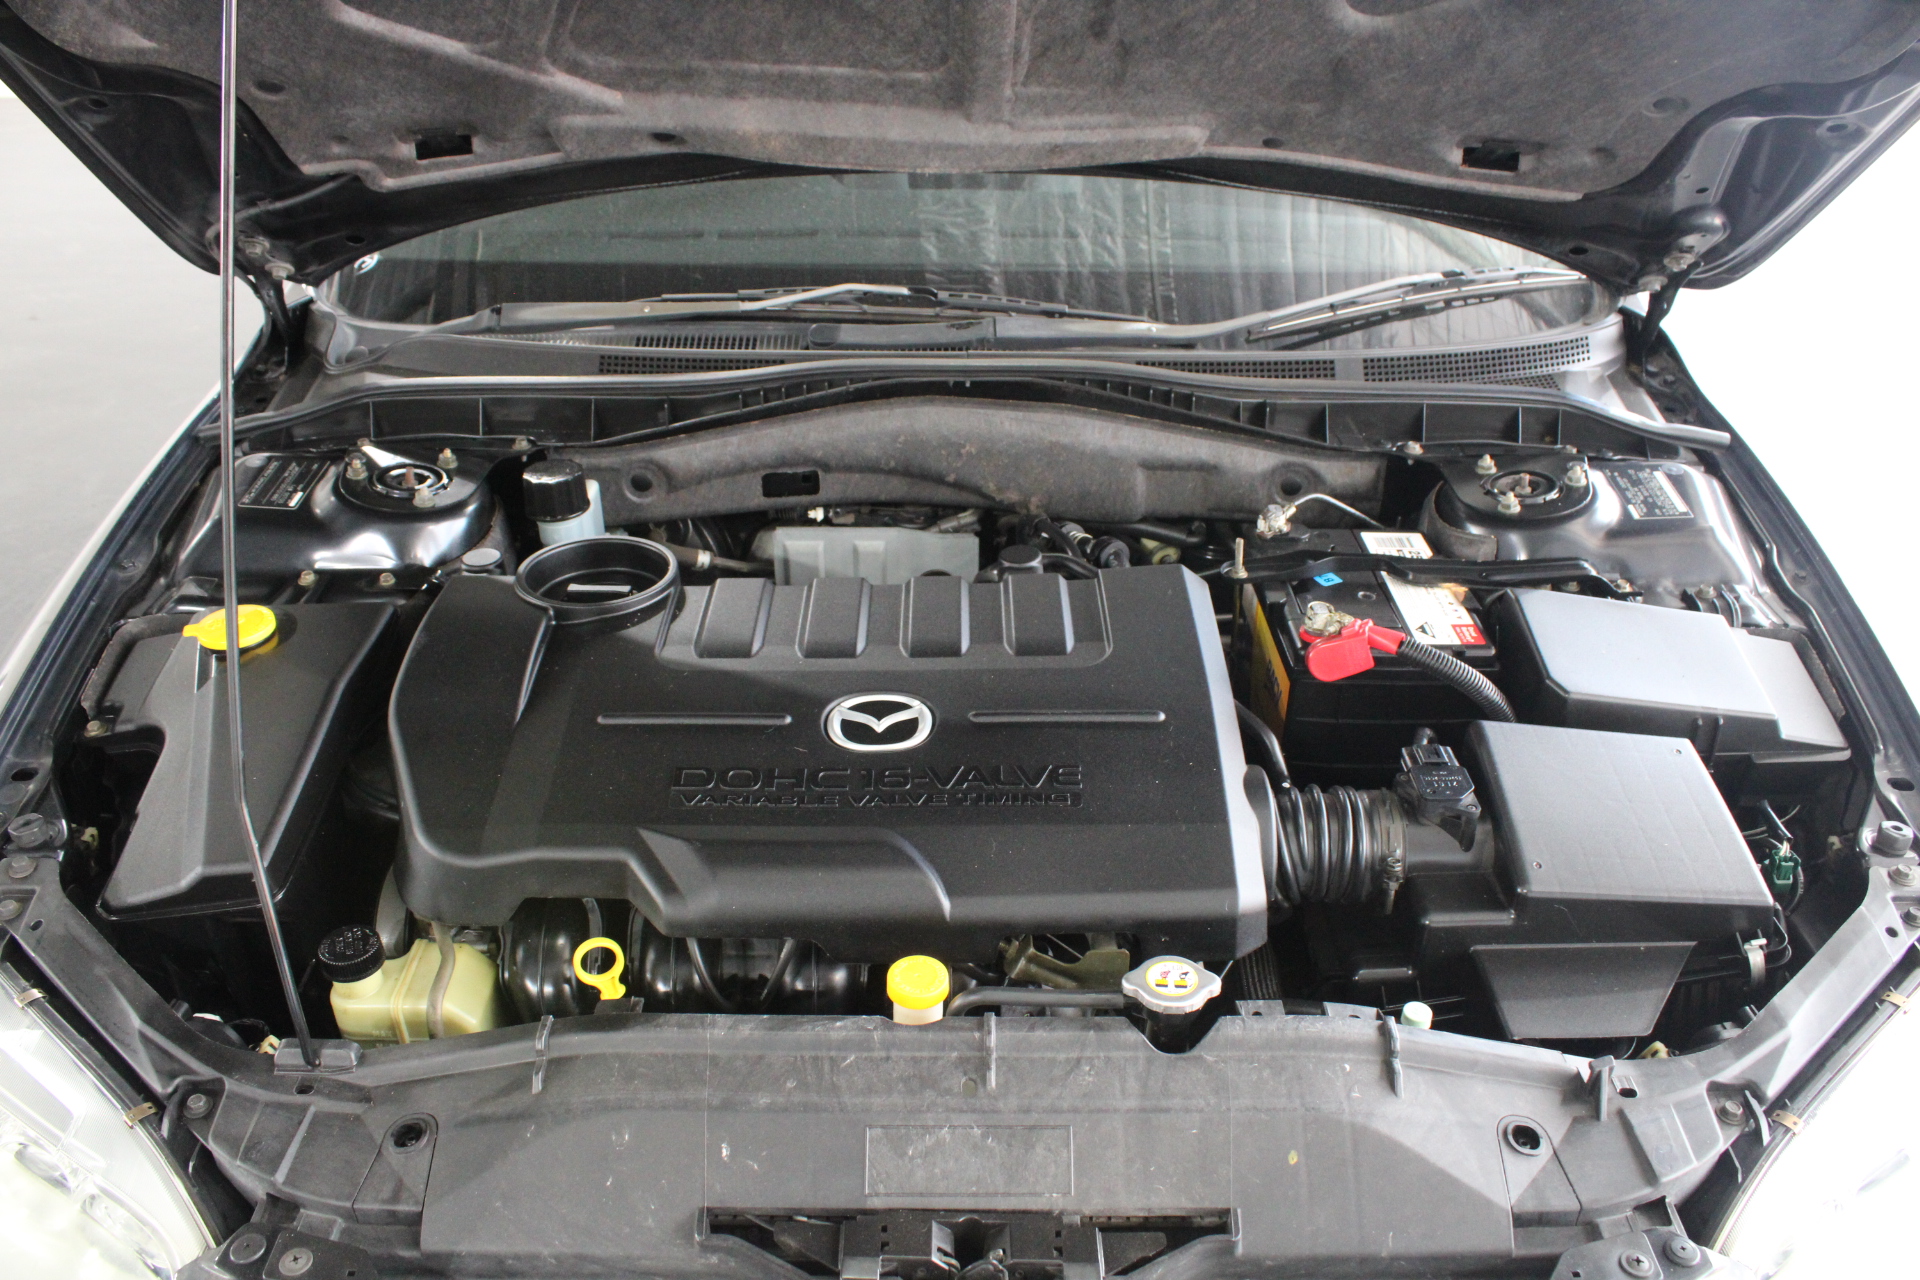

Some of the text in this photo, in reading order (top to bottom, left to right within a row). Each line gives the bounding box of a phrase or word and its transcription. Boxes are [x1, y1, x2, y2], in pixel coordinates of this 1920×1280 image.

[671, 765, 1083, 791] DOHC 16-VALVE
[680, 793, 1072, 807] VARIABLE VALVE TIMING
